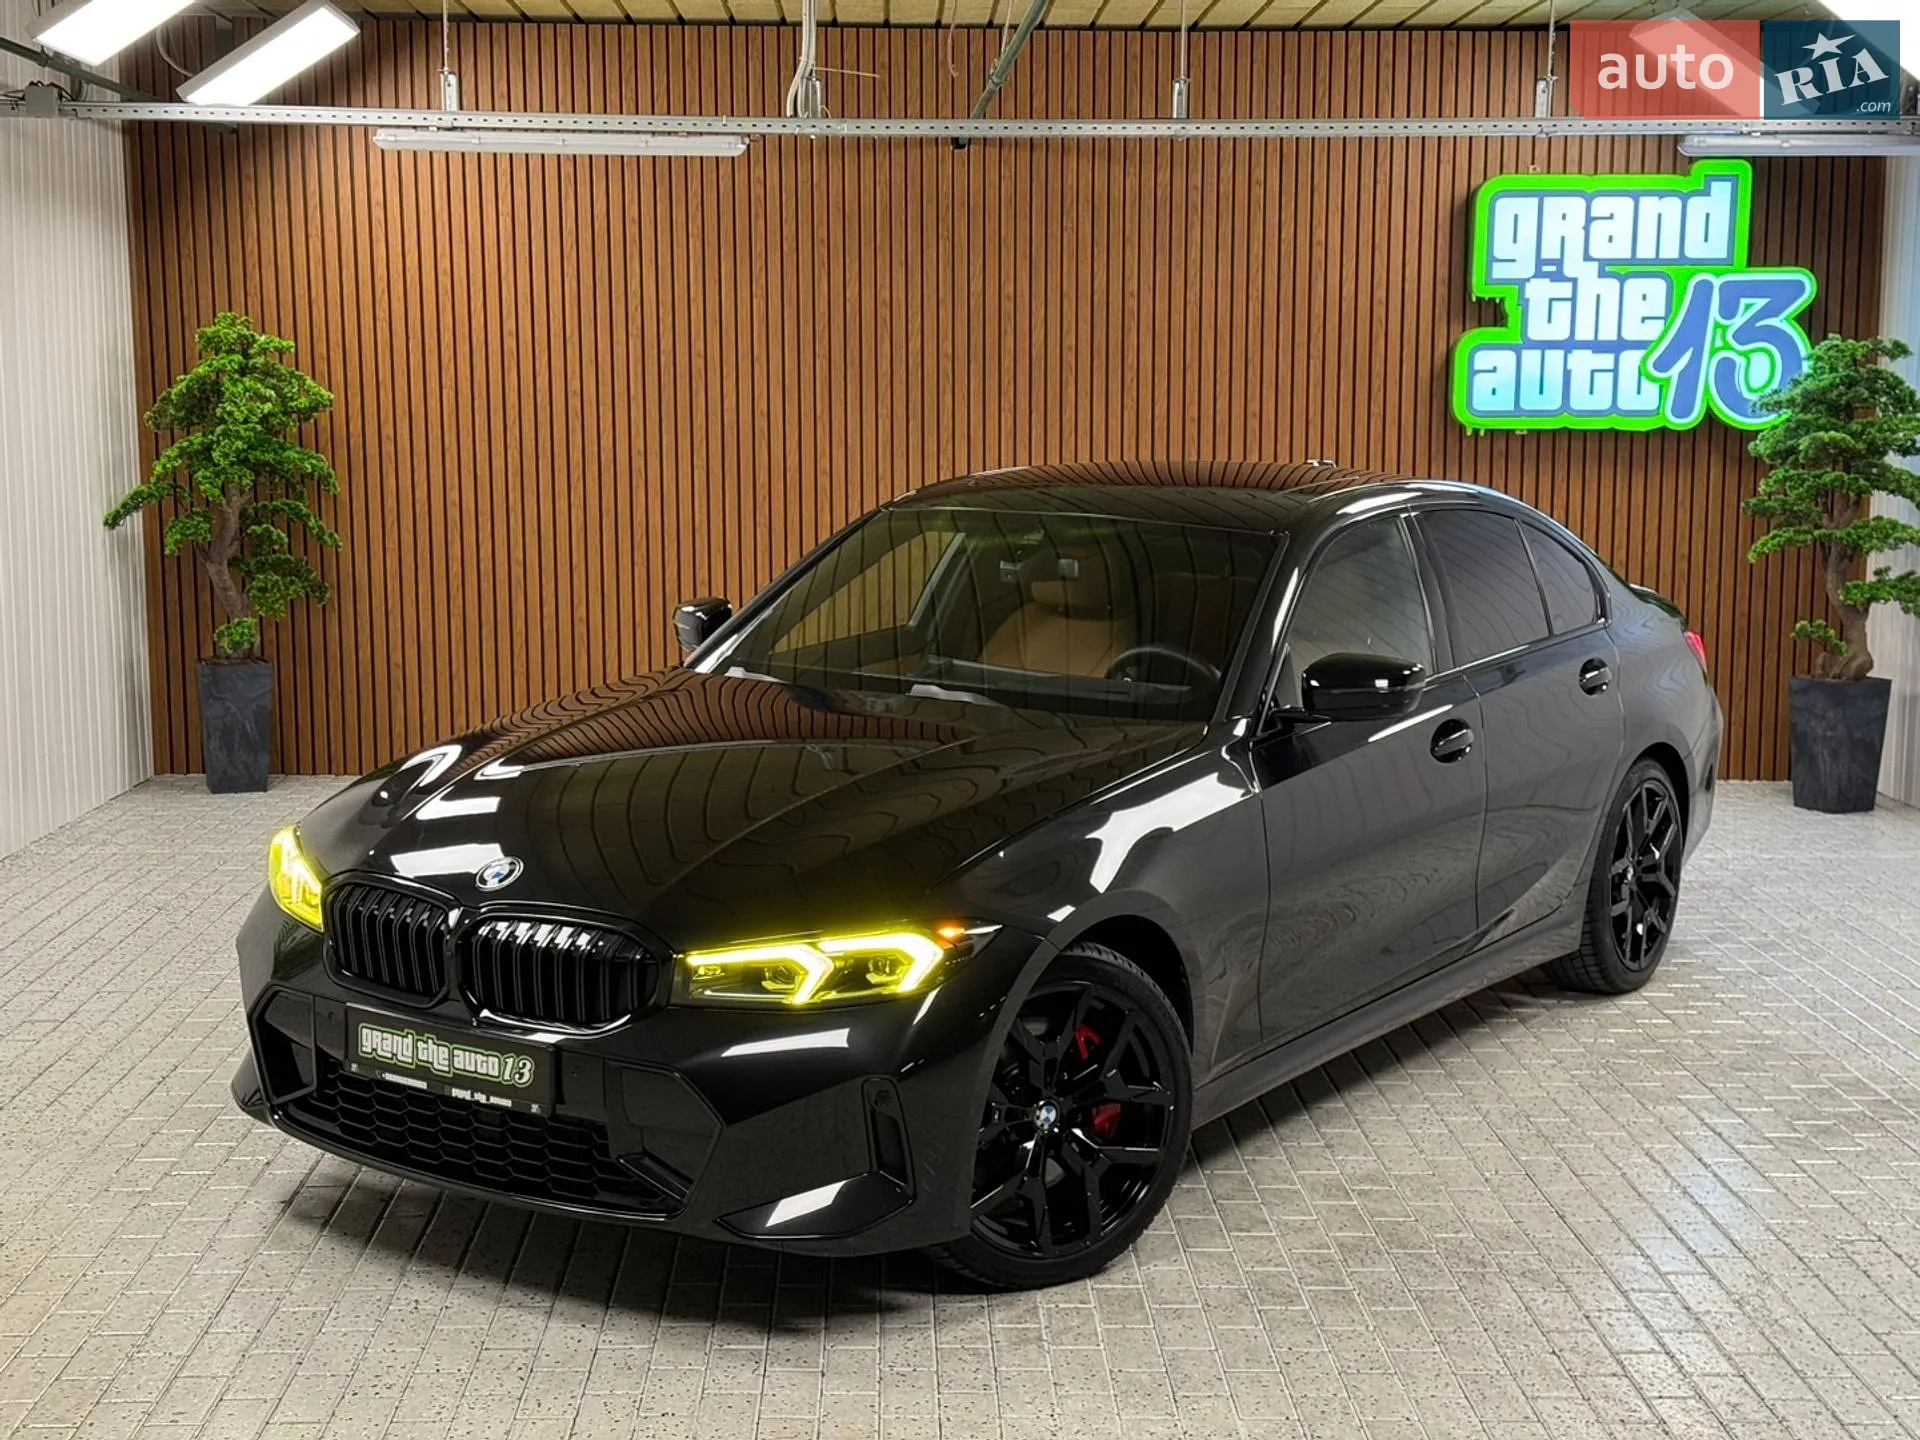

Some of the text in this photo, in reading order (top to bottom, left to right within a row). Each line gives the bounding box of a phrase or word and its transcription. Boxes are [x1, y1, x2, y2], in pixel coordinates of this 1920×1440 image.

[1524, 262, 1668, 341] the
[1648, 273, 1812, 425] 13
[417, 1038, 450, 1072] the
[502, 1055, 532, 1084] 13
